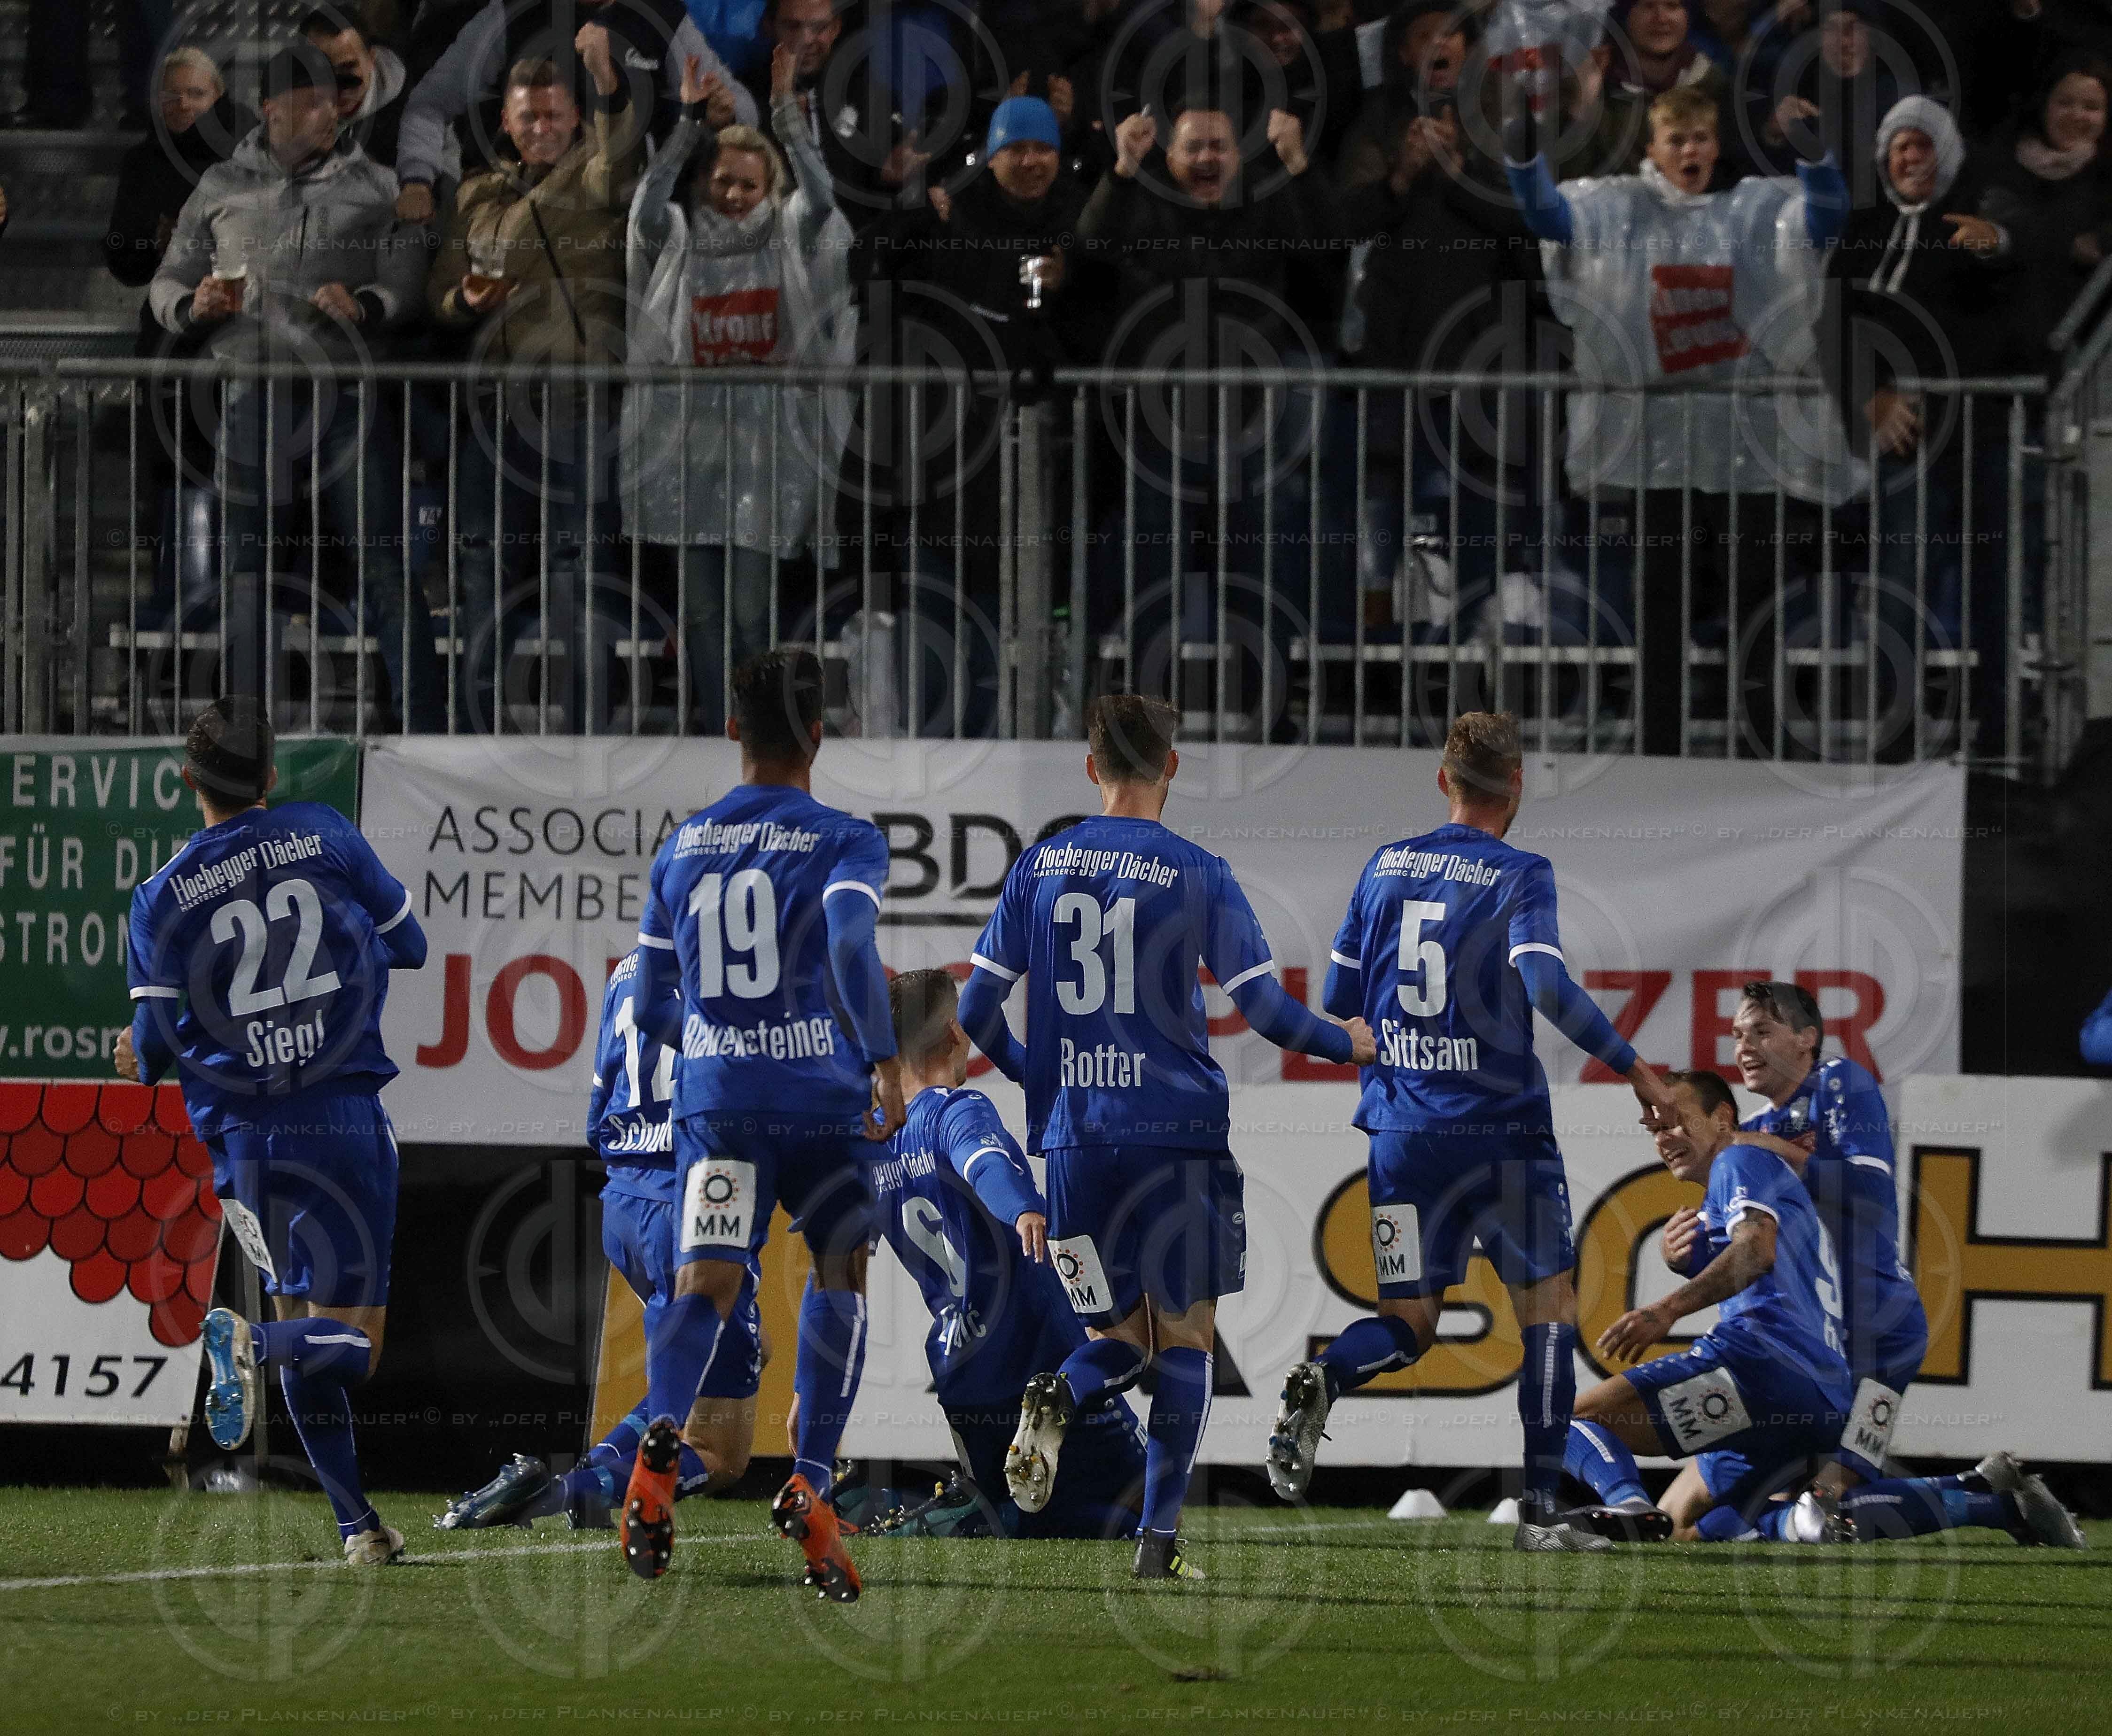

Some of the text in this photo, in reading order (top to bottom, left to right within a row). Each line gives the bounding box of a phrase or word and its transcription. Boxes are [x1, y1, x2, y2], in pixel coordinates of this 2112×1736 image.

[13, 754, 203, 811] ERVIC
[0, 822, 83, 891] FÜR
[427, 805, 704, 857] ASSOCIA
[675, 817, 822, 853] Hochegger Dächer
[870, 812, 1086, 900] BD
[169, 832, 323, 904] Hochegger Dächer
[1033, 868, 1076, 877] HARTBERG
[1034, 841, 1178, 888] Hochegger Dächer
[1373, 869, 1408, 878] HARTBERG
[1375, 846, 1501, 886] Hochegger Dächer
[180, 886, 228, 913] HARTBERG
[424, 870, 640, 922] MEMBE
[210, 879, 342, 1016] 22
[688, 868, 780, 999] 19
[1053, 893, 1135, 1015] 31
[1397, 899, 1447, 1016] 5
[246, 1009, 325, 1067] Siegl
[1061, 1038, 1146, 1087] Rotter
[1380, 1018, 1478, 1071] Sittsam
[695, 1214, 740, 1237] MM
[1379, 1253, 1405, 1276] MM
